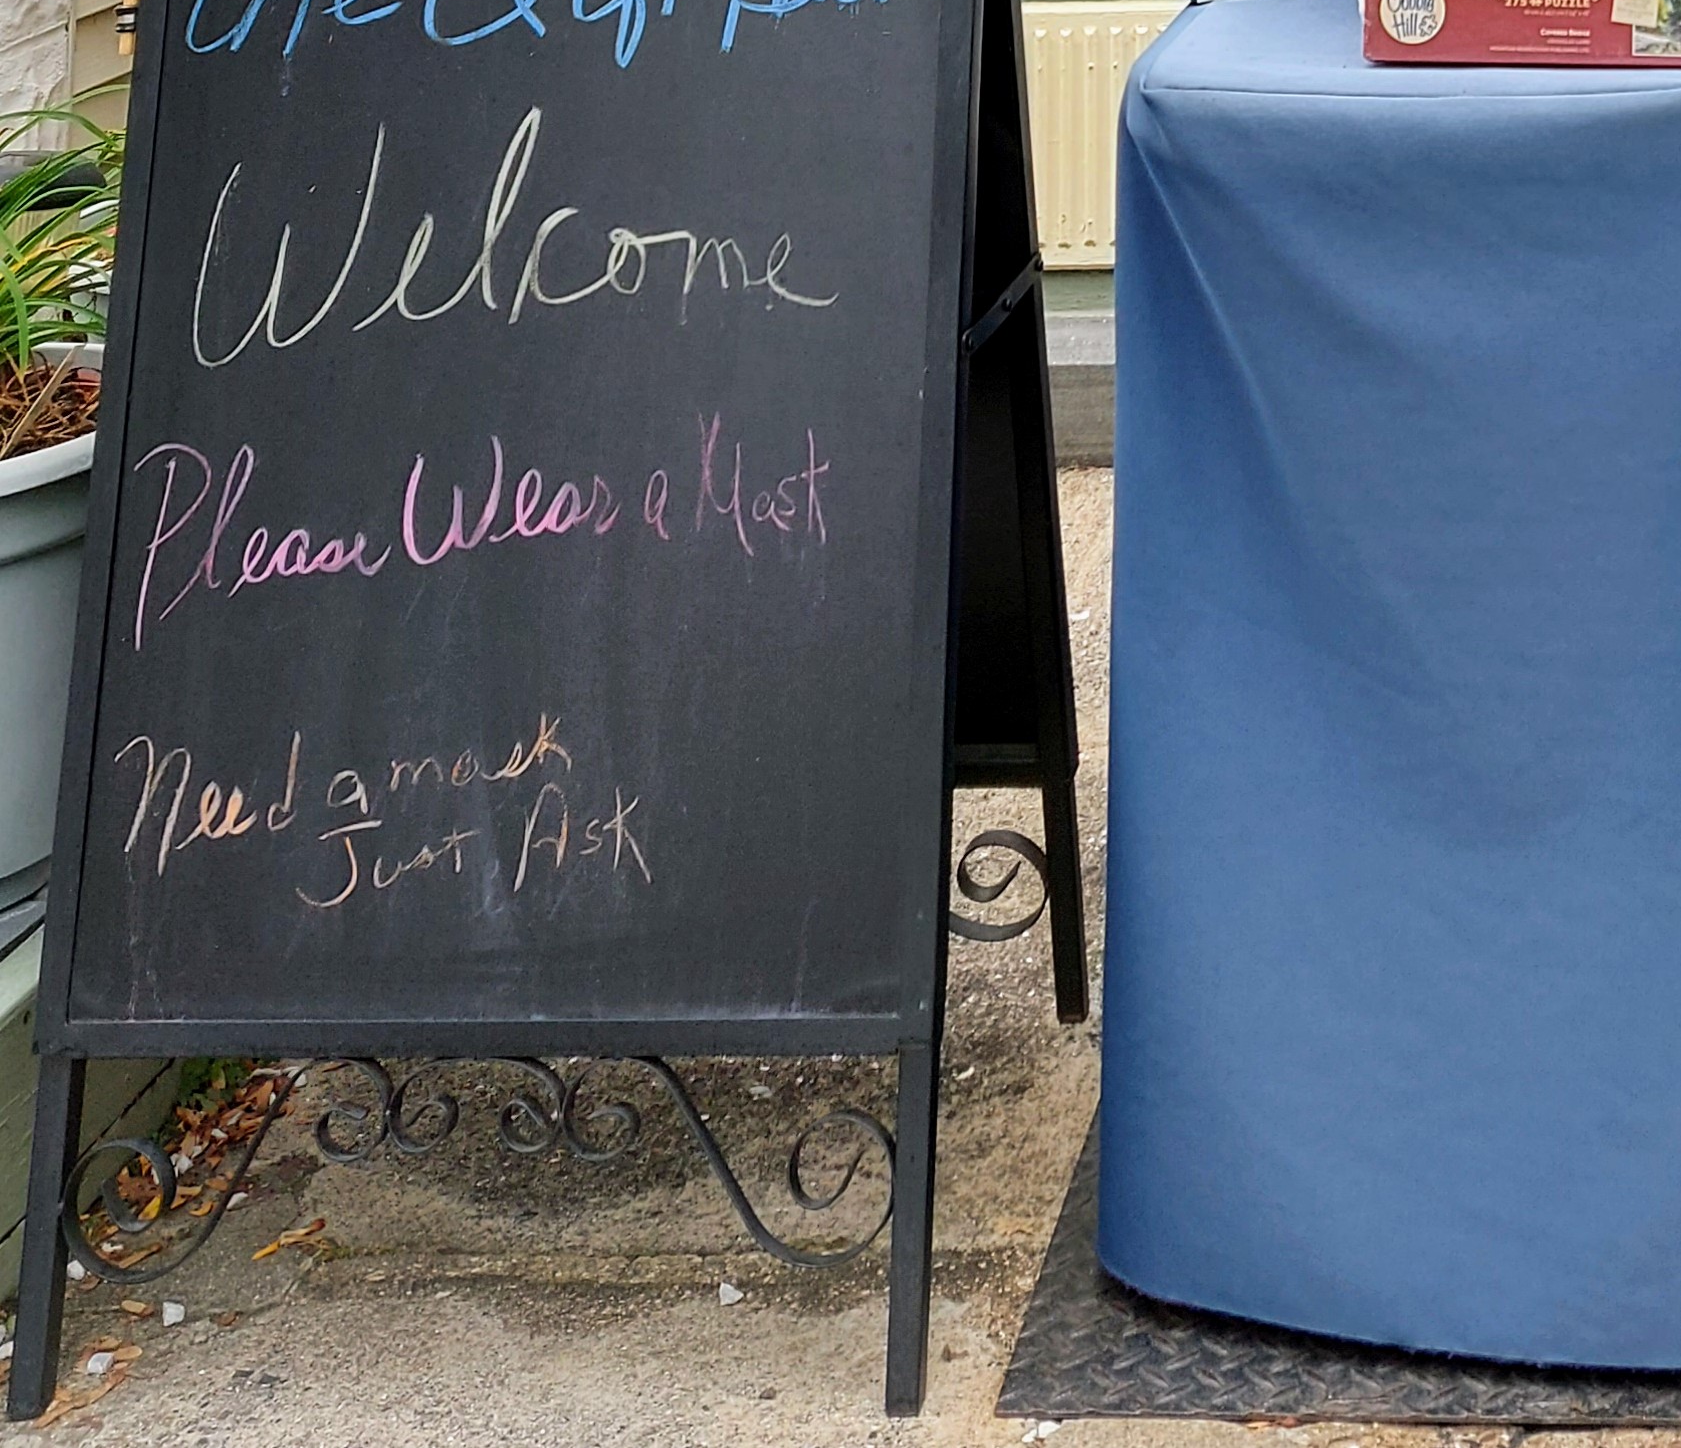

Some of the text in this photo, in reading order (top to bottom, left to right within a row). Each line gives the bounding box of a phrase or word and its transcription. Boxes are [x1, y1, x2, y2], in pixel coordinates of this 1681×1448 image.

[1391, 11, 1418, 39] Hill
[192, 106, 839, 369] Welcome
[132, 441, 392, 651] Please
[400, 433, 620, 570] Wear
[295, 782, 653, 909] Just Ask
